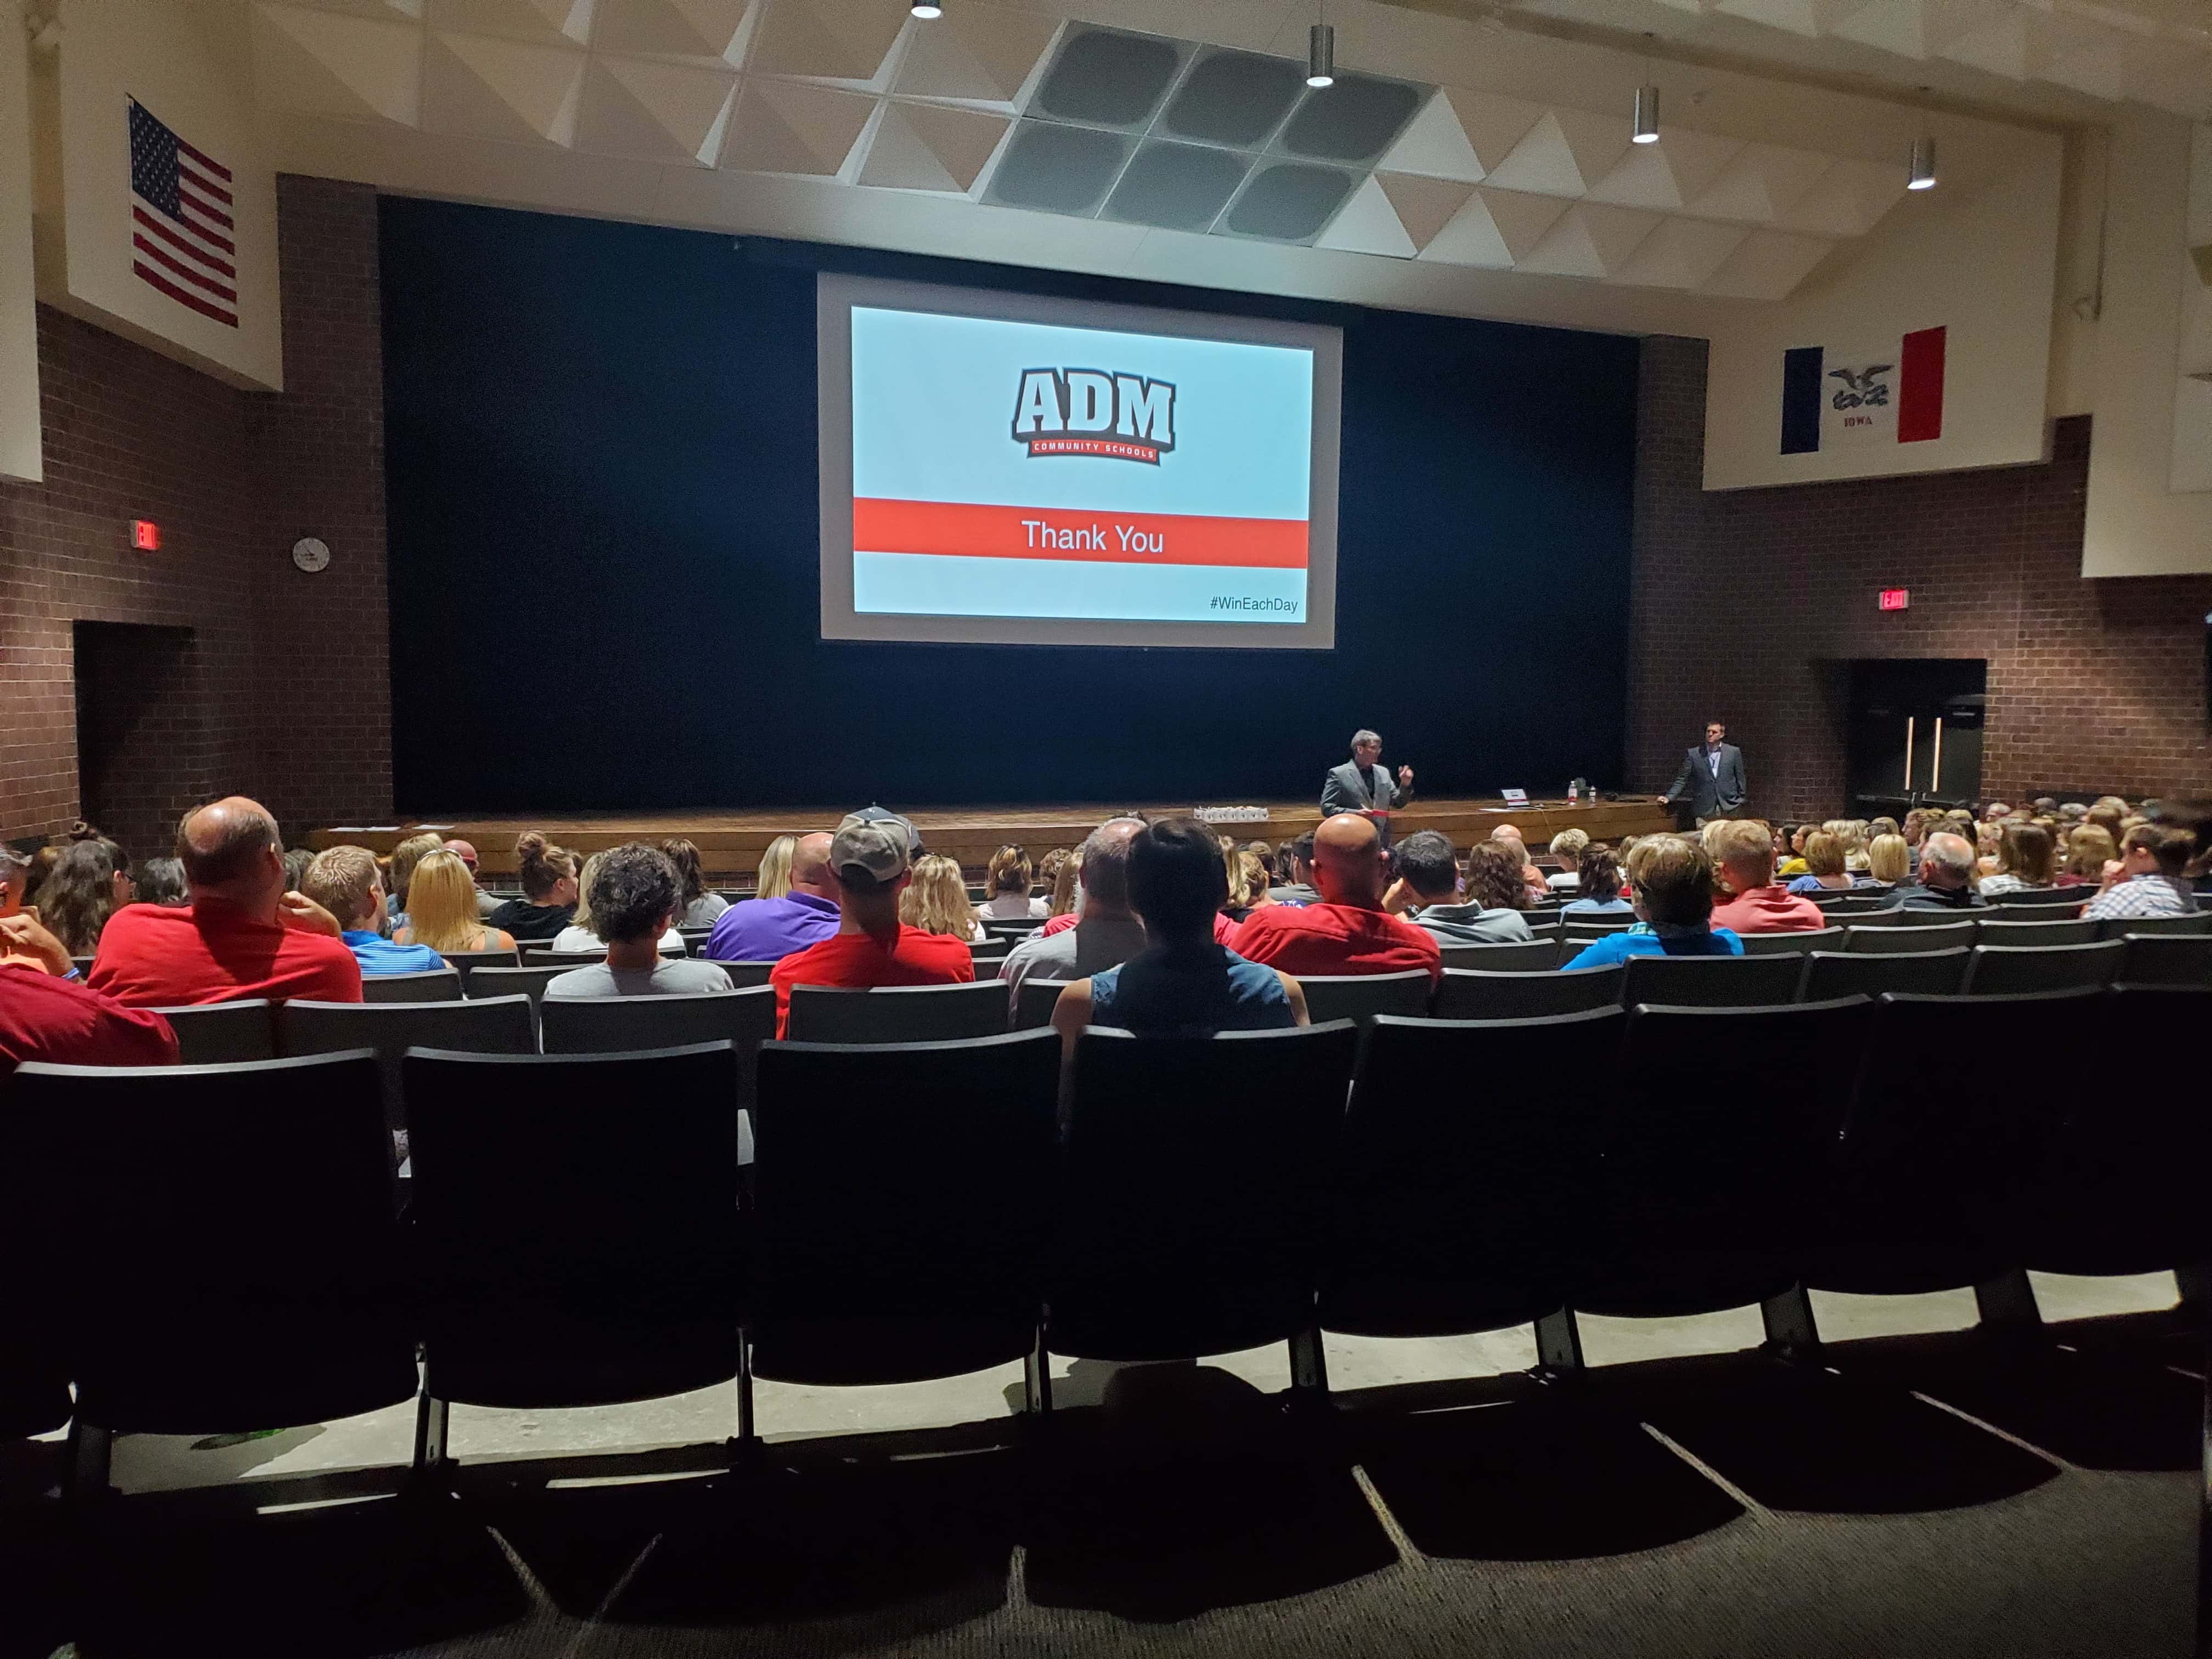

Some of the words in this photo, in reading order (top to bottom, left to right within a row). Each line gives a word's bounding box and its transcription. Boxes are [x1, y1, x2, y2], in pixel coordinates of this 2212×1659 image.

[1016, 371, 1172, 444] ADM
[1844, 416, 1872, 427] IOWA
[1034, 442, 1099, 451] COMMUNITY
[1105, 444, 1153, 458] SCHOOLS
[1021, 520, 1107, 550] Thank
[1115, 525, 1163, 553] You
[1210, 596, 1298, 614] #WinEachDay
